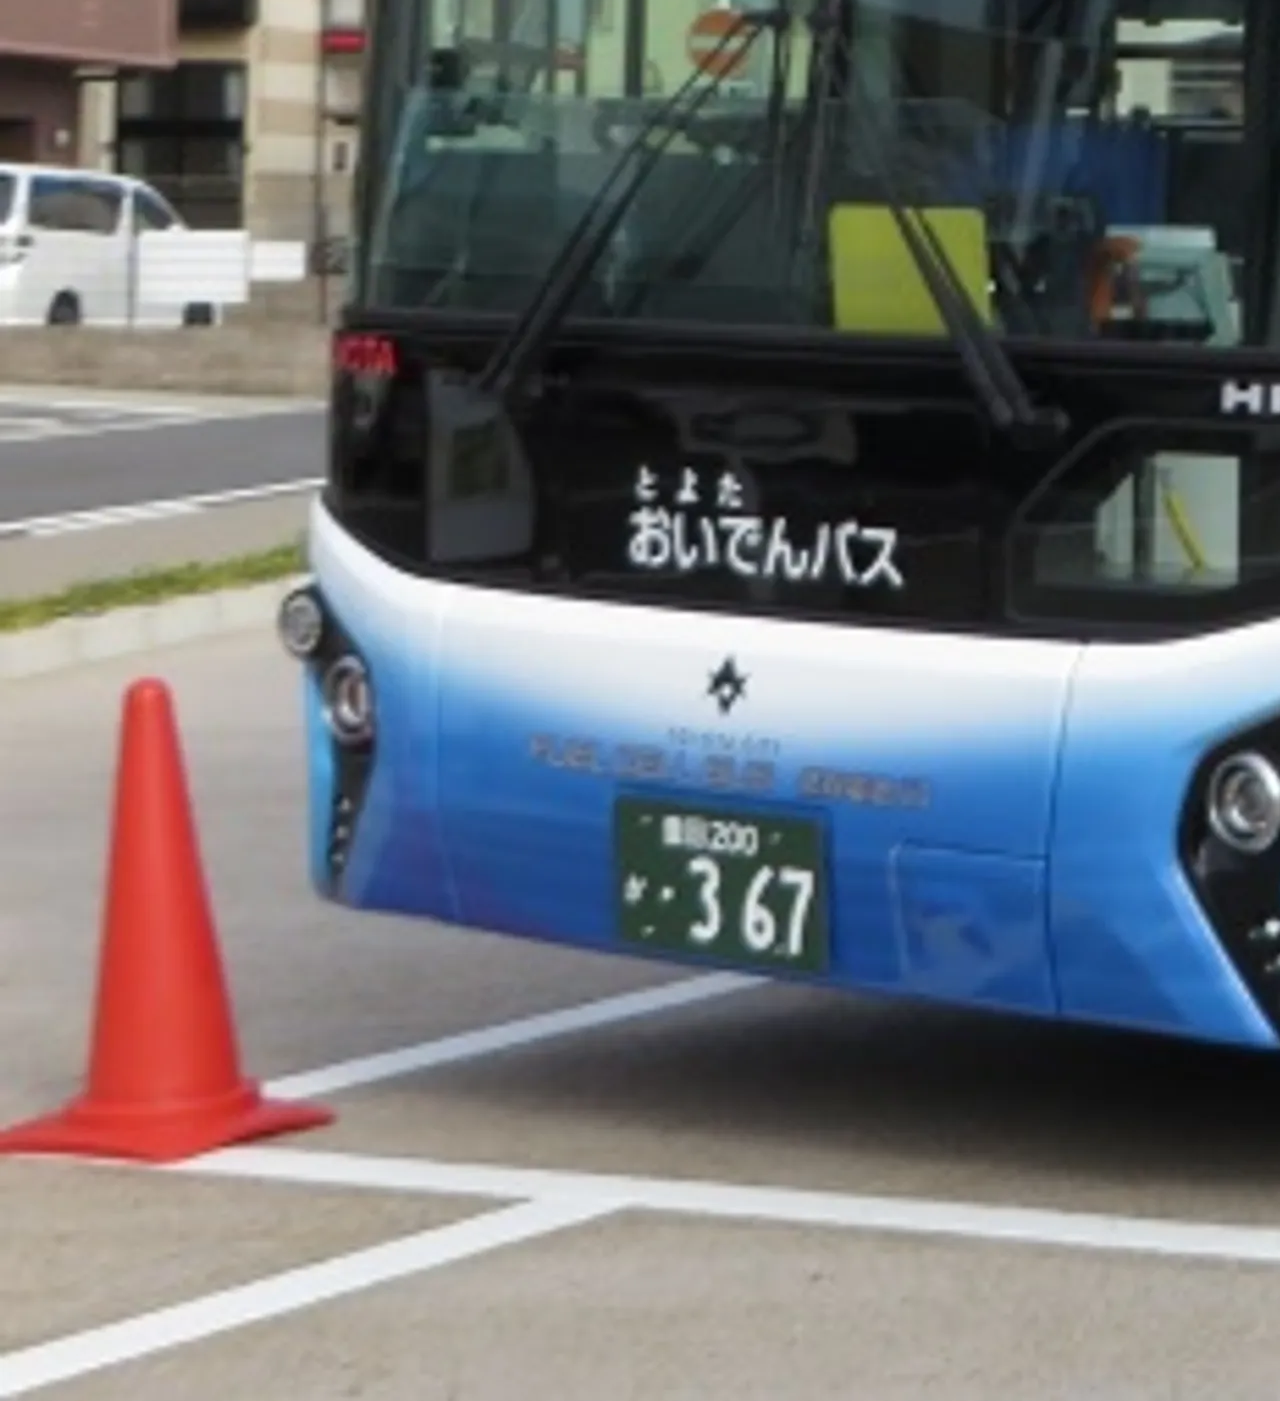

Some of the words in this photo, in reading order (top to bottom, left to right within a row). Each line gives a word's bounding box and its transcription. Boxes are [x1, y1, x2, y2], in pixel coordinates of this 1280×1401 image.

[635, 464, 744, 508] とよた
[628, 506, 905, 588] おいでんバス
